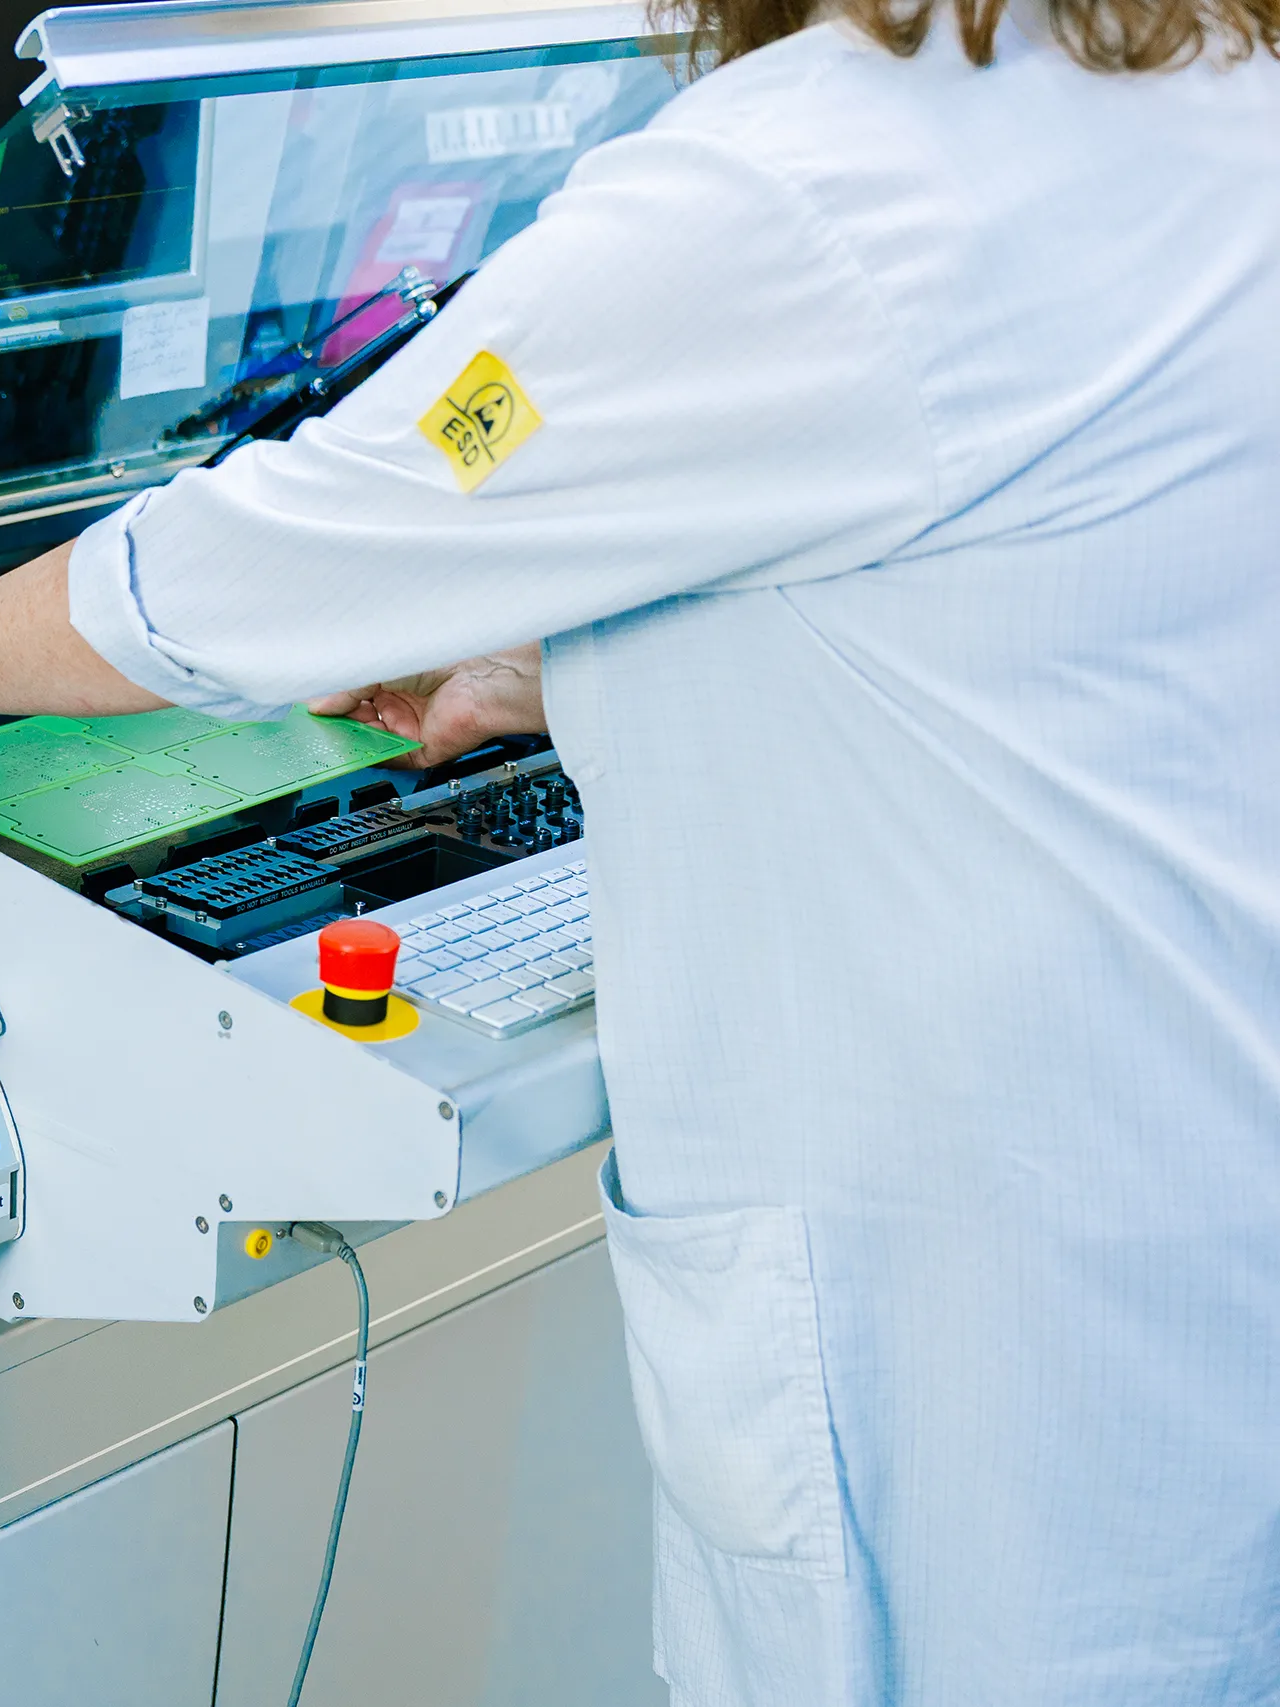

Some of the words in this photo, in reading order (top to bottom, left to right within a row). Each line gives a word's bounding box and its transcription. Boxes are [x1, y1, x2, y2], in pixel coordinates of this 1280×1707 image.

[441, 417, 479, 466] ESD
[329, 846, 337, 854] DO
[339, 843, 349, 851] NOT
[351, 837, 368, 847] INSERT
[370, 831, 387, 840] TOOLS
[388, 822, 413, 836] MANUALLY
[236, 904, 245, 912] DO
[247, 900, 258, 909] NOT
[260, 893, 278, 905] INSERT
[281, 887, 298, 897] TOOLS
[300, 877, 327, 891] MANUALLY
